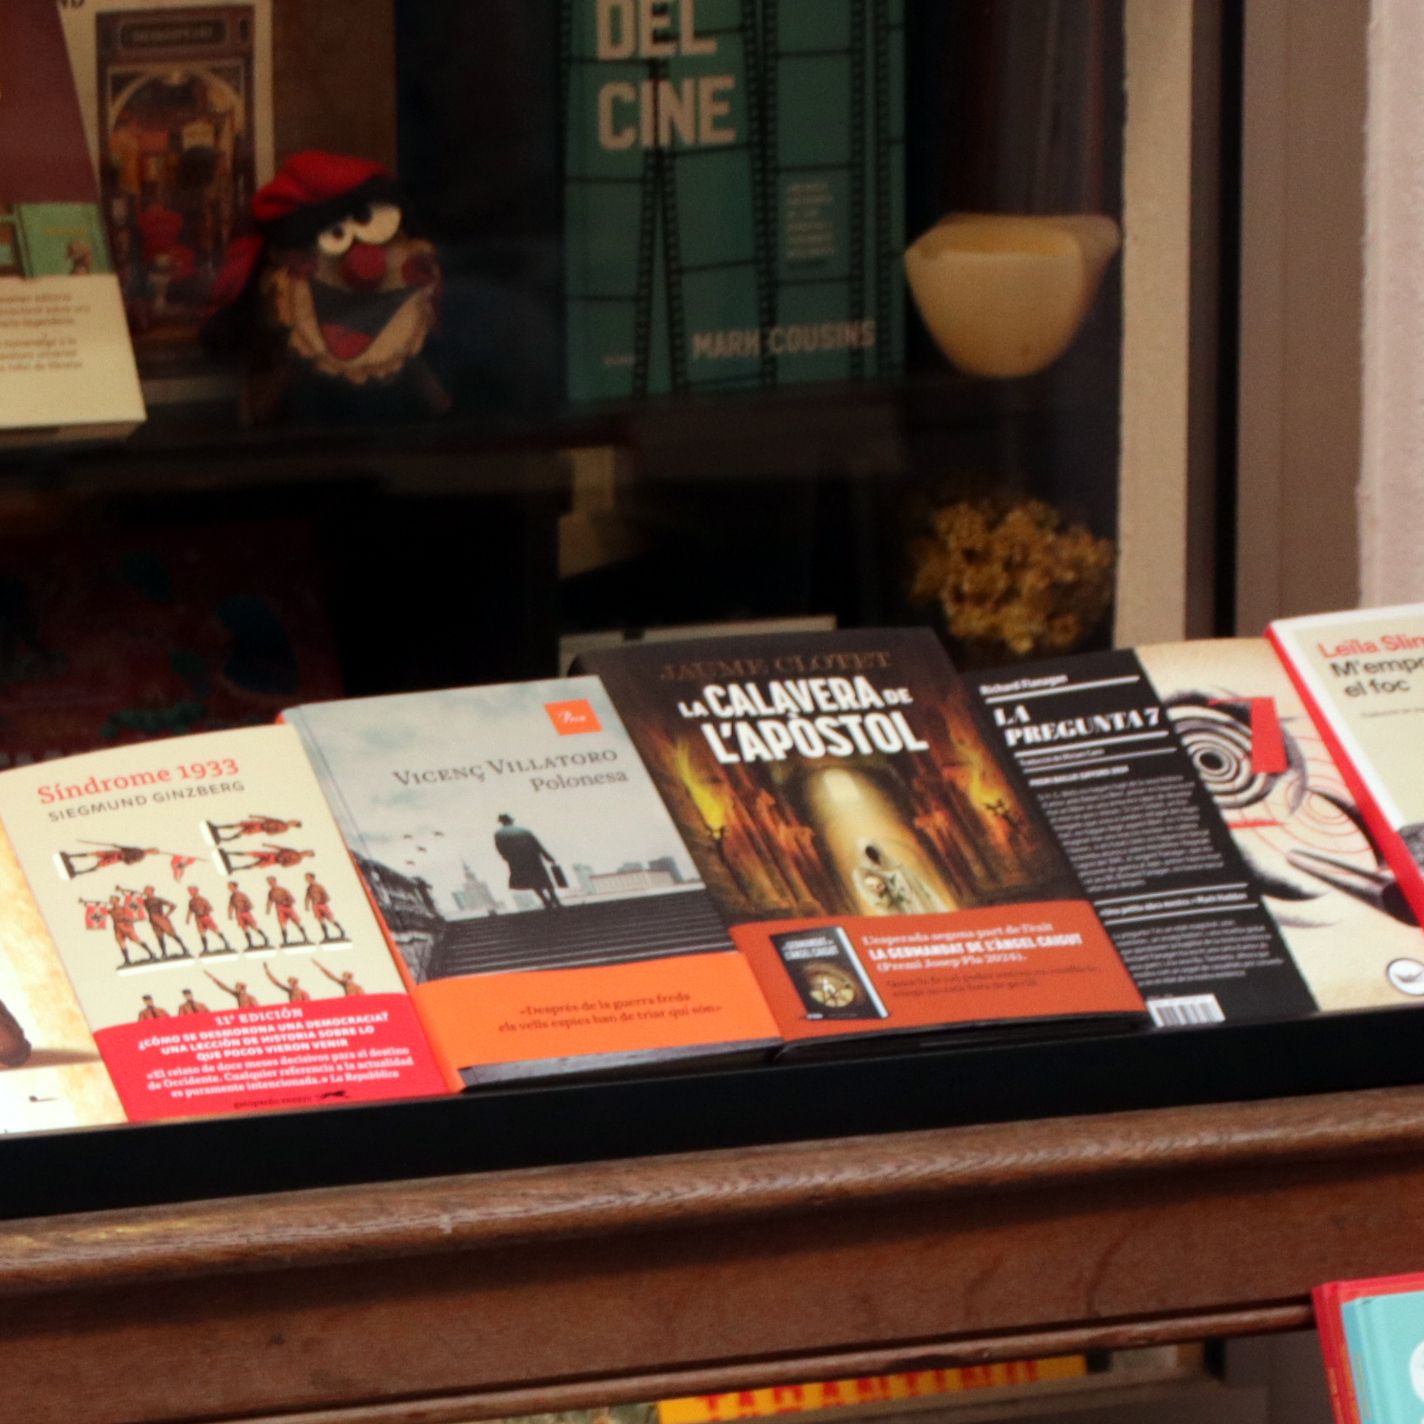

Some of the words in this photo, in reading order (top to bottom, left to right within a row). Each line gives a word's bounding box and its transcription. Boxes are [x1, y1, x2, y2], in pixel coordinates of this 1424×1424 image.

[598, 0, 717, 60] DEL
[598, 75, 736, 150] CINE
[693, 329, 760, 358] MARK
[770, 319, 876, 354] COUSINS
[660, 657, 768, 682] JAUME
[1344, 683, 1366, 698] el
[1367, 676, 1410, 694] foc
[678, 700, 709, 718] LA
[702, 674, 885, 718] CALAVERA
[883, 687, 914, 706] DE
[993, 705, 1031, 726] LA
[701, 709, 930, 764] L'APÒSTOL
[1004, 710, 1145, 747] PREGUNTA
[1144, 707, 1161, 727] 7
[36, 769, 172, 804] Síndrome
[177, 758, 240, 780] 1933
[393, 764, 486, 787] VICENÇ
[487, 749, 618, 777] VILLATORO
[530, 770, 629, 795] Polonesa
[48, 796, 148, 822] SIEGMUND
[152, 780, 245, 804] GINZBERG
[239, 1007, 304, 1024] EDICIÓN
